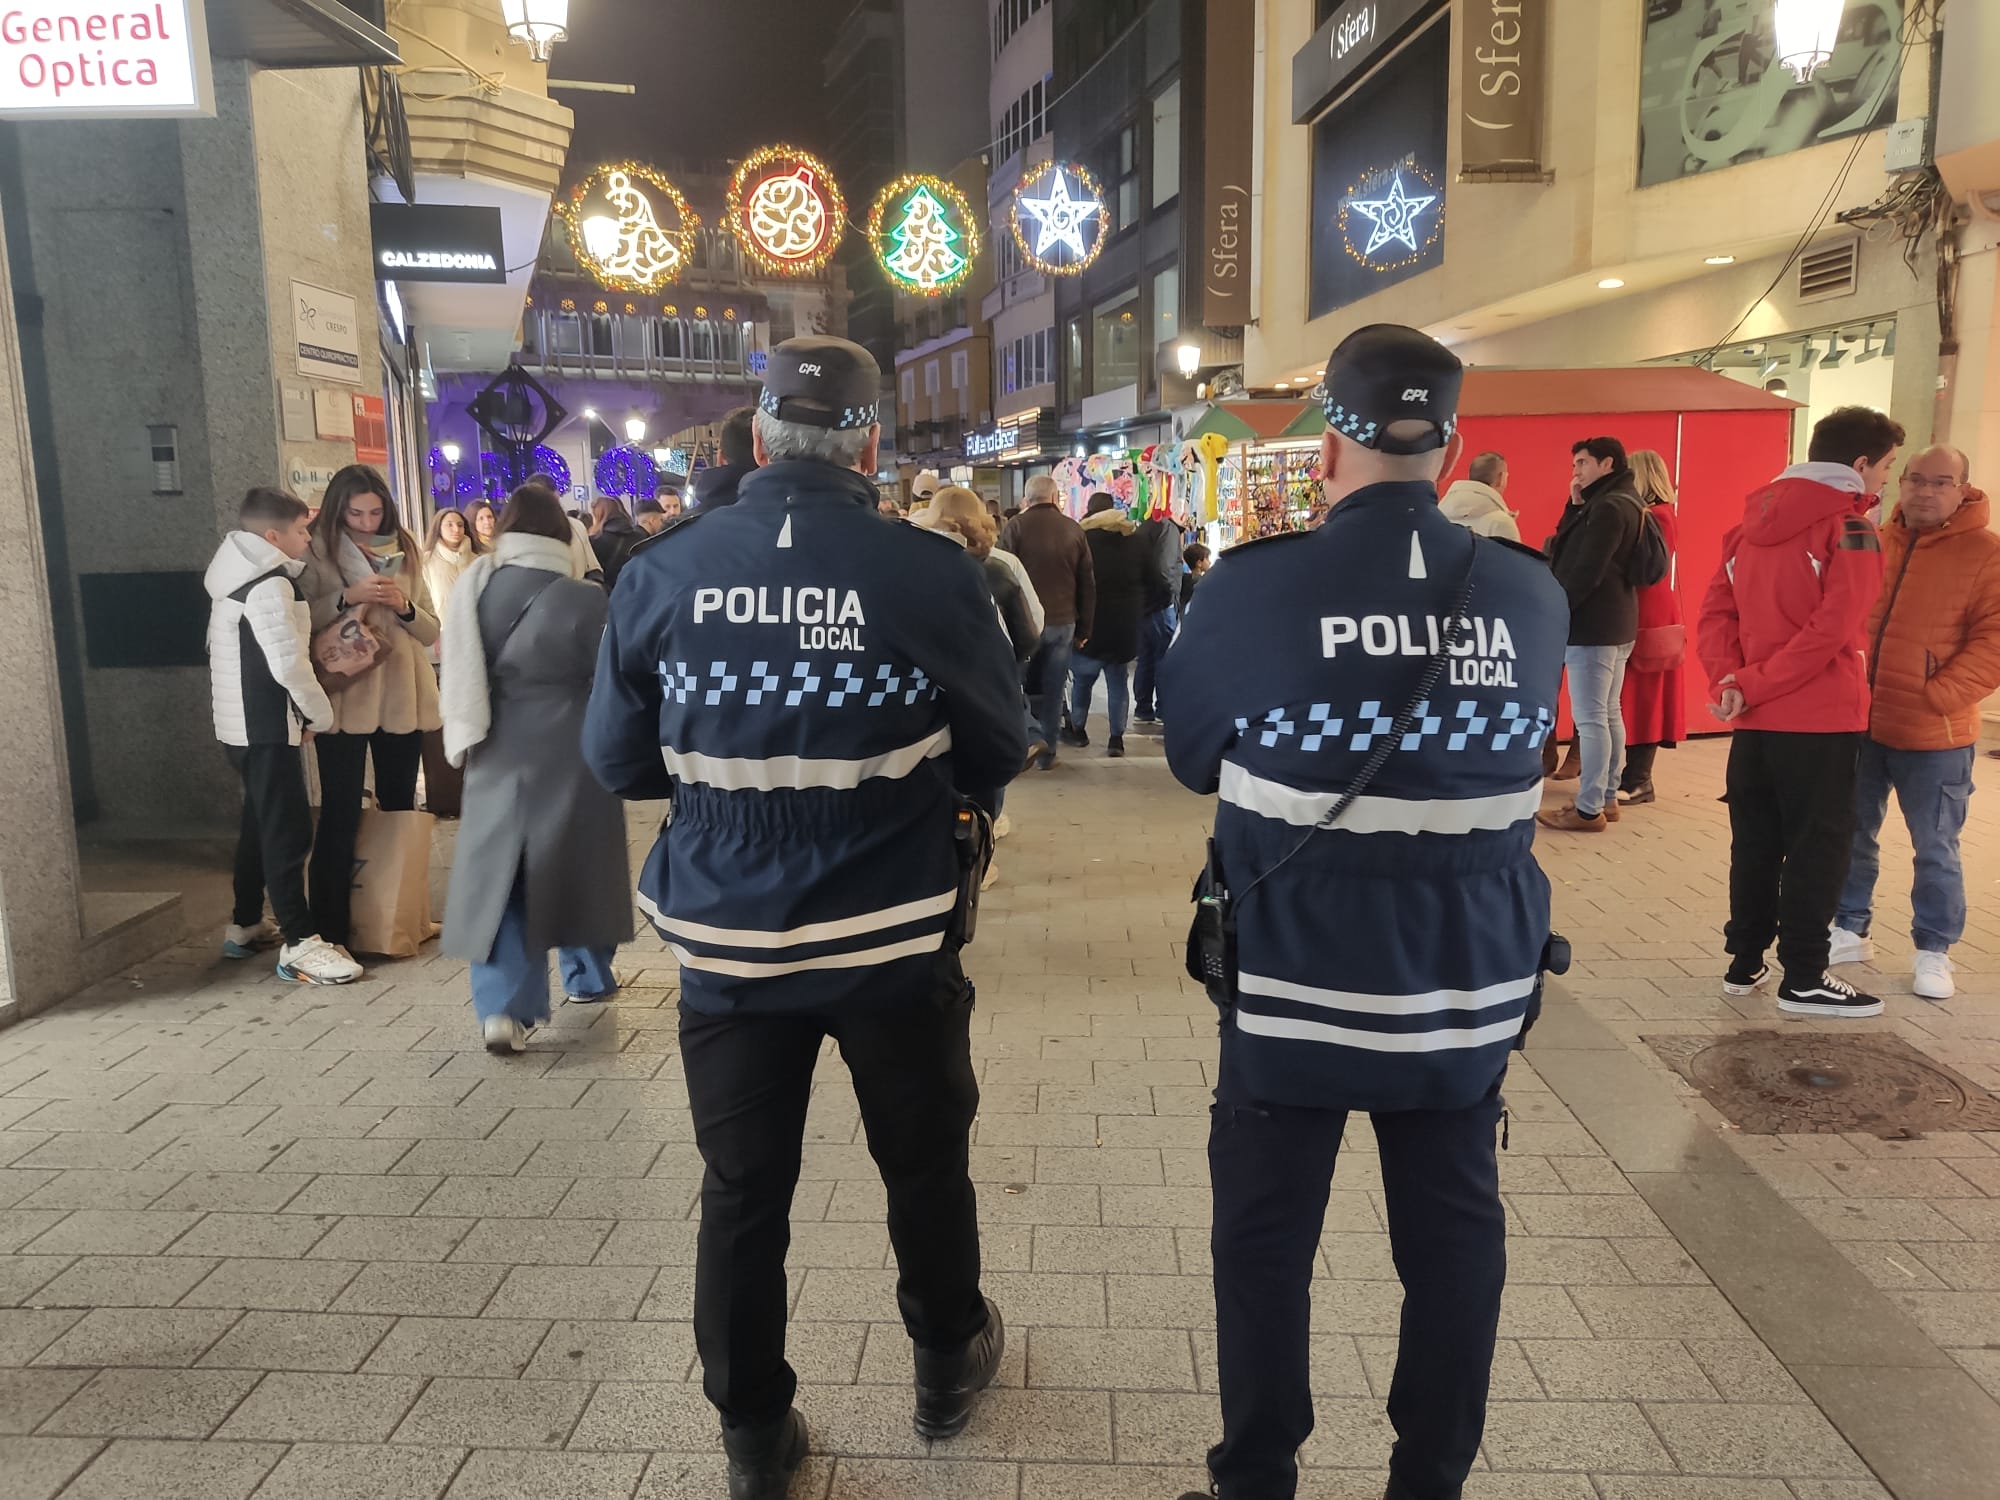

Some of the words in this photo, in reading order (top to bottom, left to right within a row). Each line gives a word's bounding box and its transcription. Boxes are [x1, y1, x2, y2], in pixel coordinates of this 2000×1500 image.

[1, 3, 170, 45] General
[19, 49, 158, 97] Optica
[382, 251, 497, 270] CALZEDONIA
[325, 321, 348, 335] CRESPO
[300, 345, 320, 358] CENTRO
[798, 362, 822, 377] CPL
[1401, 388, 1429, 402] CPL
[575, 486, 585, 500] P
[693, 586, 866, 625] POLICIA
[799, 626, 865, 651] LOCAL
[1320, 615, 1517, 660] POLICIA
[1450, 659, 1518, 688] LOCAL
